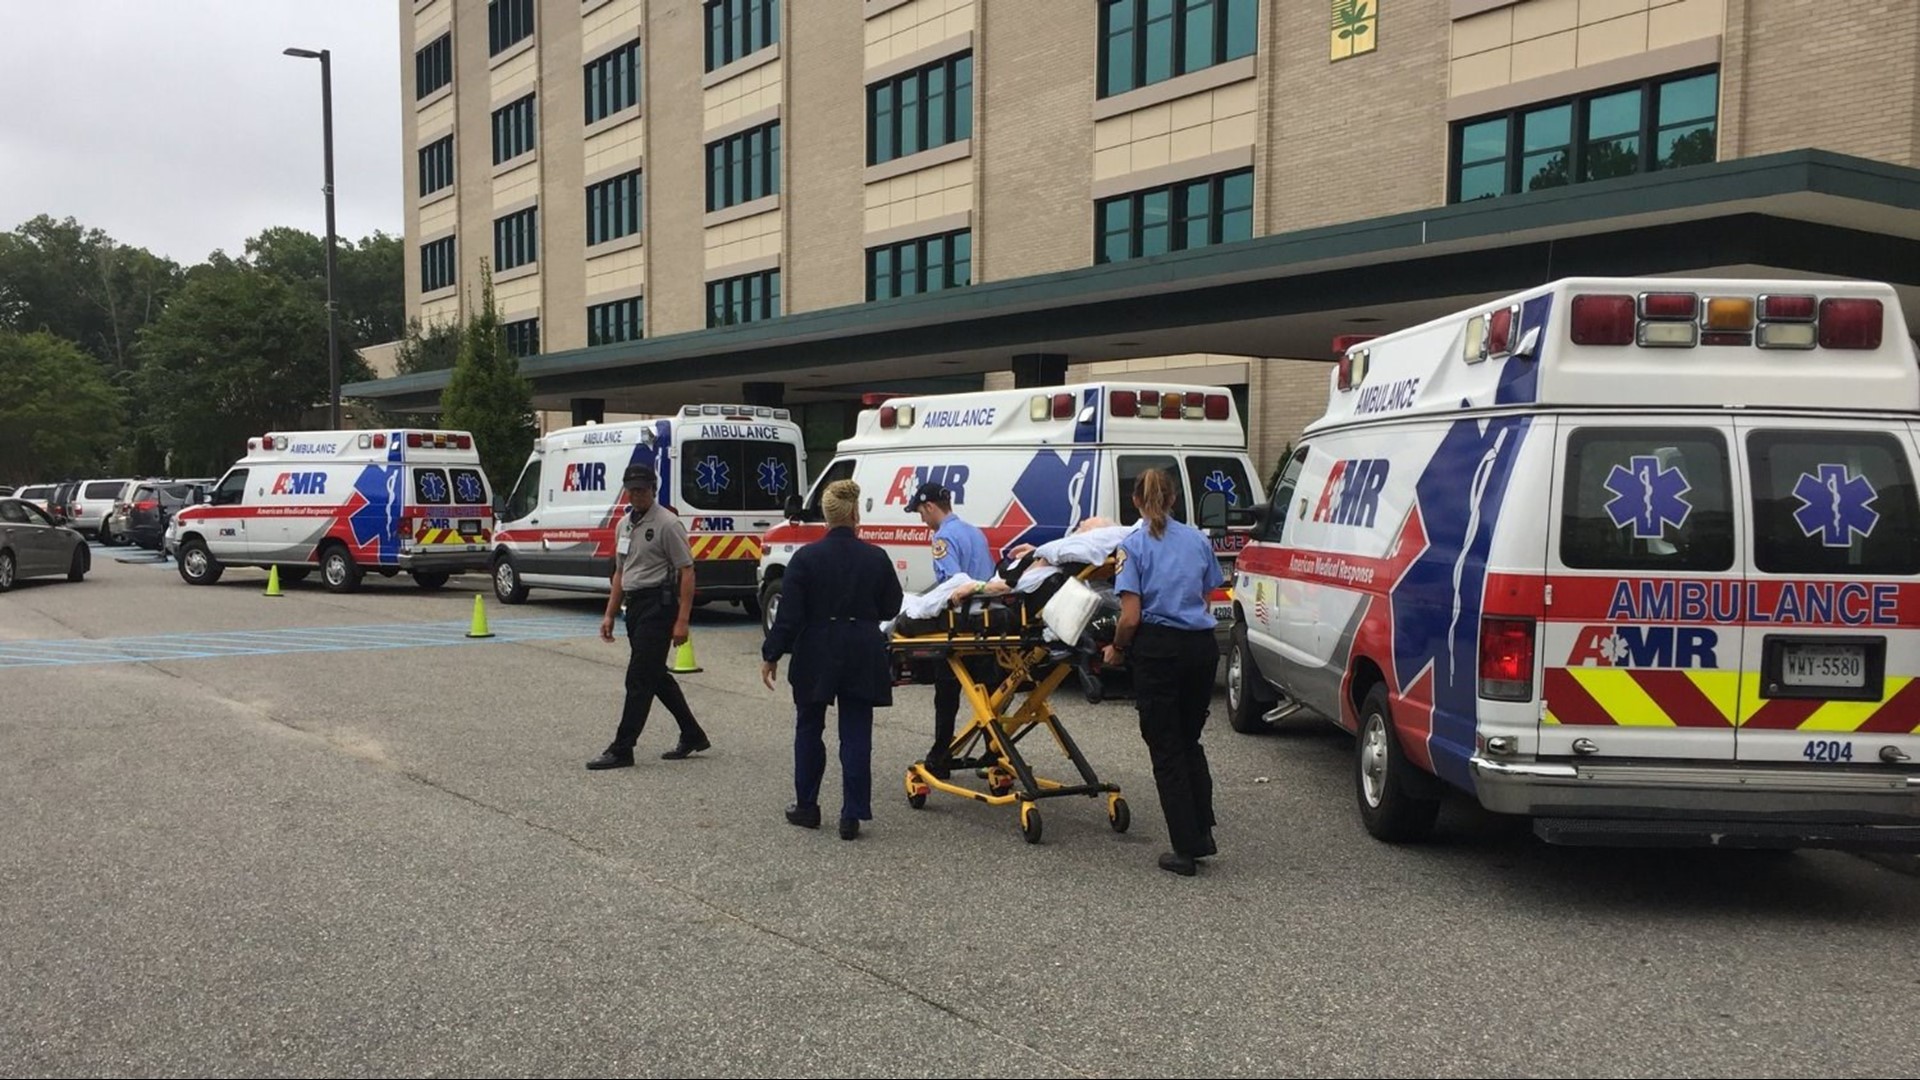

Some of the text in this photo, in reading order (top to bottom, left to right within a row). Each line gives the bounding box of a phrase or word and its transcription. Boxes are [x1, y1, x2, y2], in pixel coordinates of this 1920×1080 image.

[1353, 378, 1420, 416] AMBULANCE
[922, 408, 996, 428] AMBULANCE
[582, 430, 623, 444] AMBULANCE
[701, 424, 780, 440] AMBULANCE
[290, 443, 337, 454] AMBULANCE
[271, 472, 328, 494] AMR
[562, 462, 606, 492] AMR
[1312, 459, 1390, 528] AMR
[420, 518, 450, 529] AMR
[690, 517, 735, 531] AMR
[857, 528, 895, 541] American
[894, 528, 928, 541] Medical
[1289, 553, 1375, 586] American Medical Response
[1605, 579, 1900, 625] AMBULANCE
[1566, 626, 1719, 669] AMR
[1802, 741, 1853, 762] 4204
